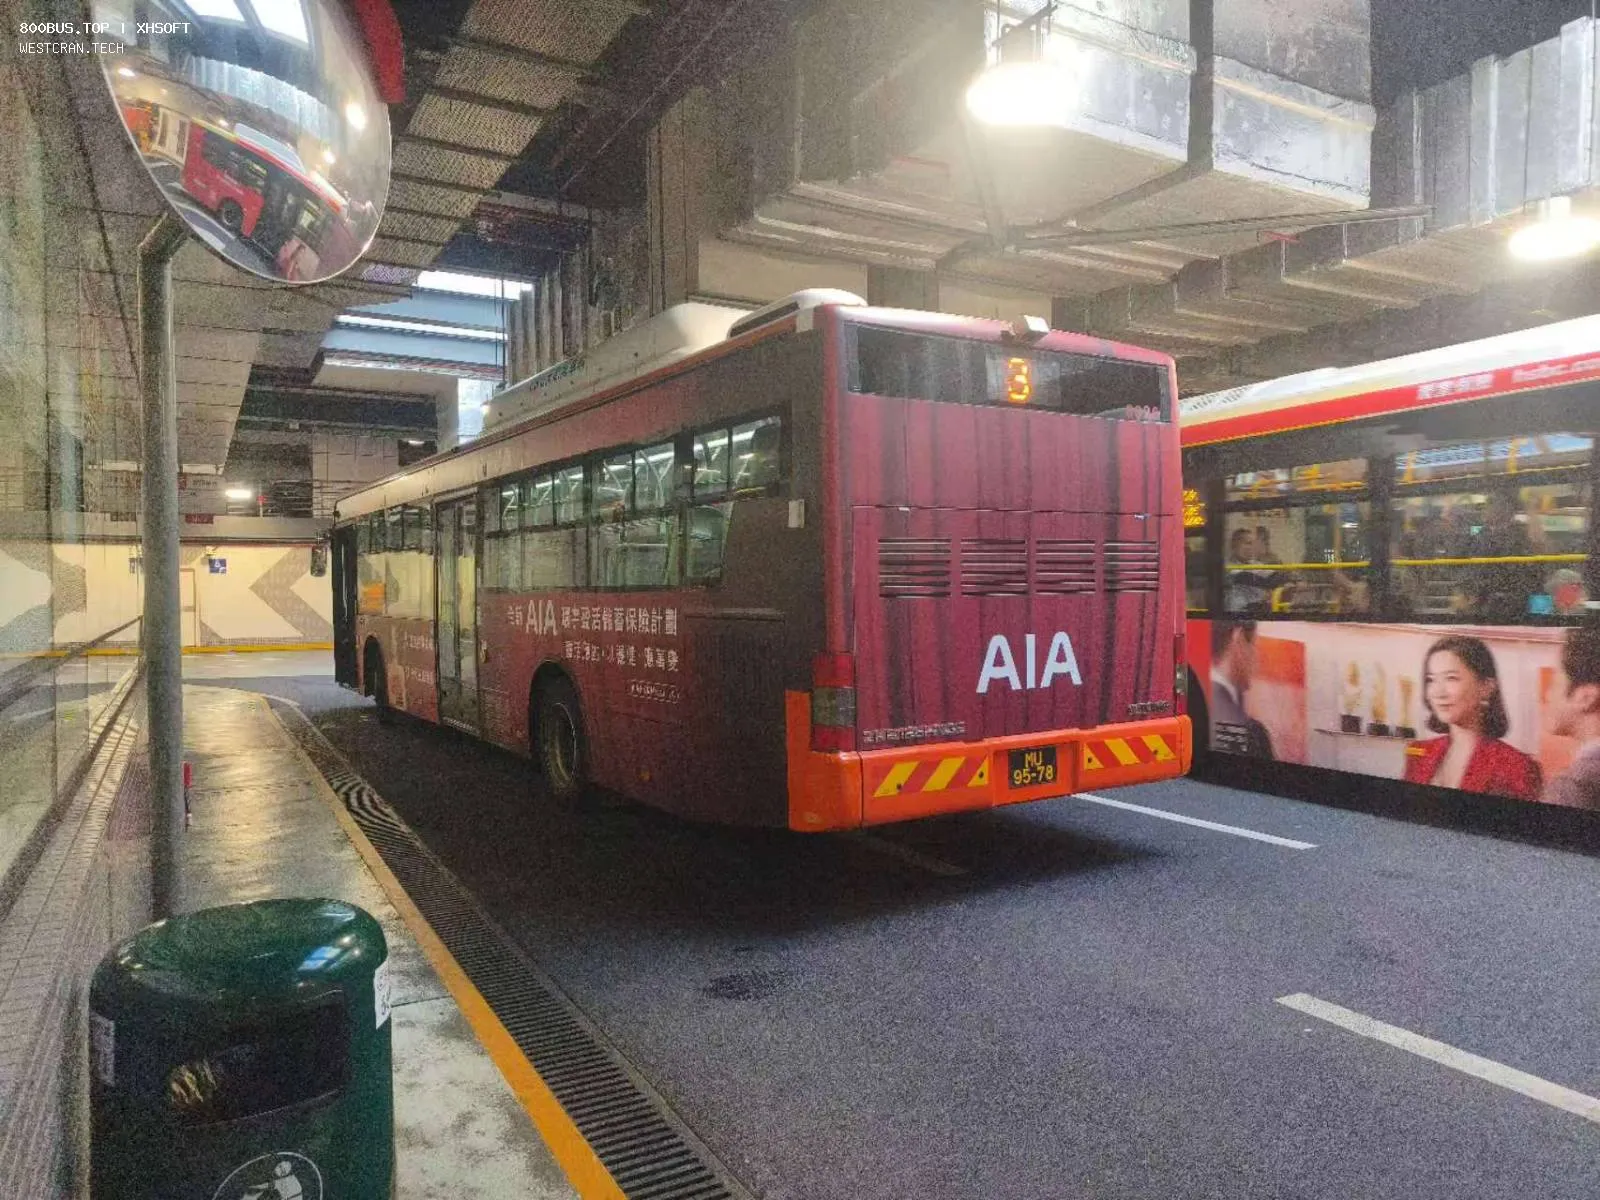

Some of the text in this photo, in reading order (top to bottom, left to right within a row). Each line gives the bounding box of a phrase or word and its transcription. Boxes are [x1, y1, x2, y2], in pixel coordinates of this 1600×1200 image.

[1007, 357, 1032, 403] 3
[525, 599, 558, 636] AIA
[976, 631, 1083, 693] AIA
[1013, 765, 1054, 785] 95-78
[1024, 751, 1043, 767] MU
